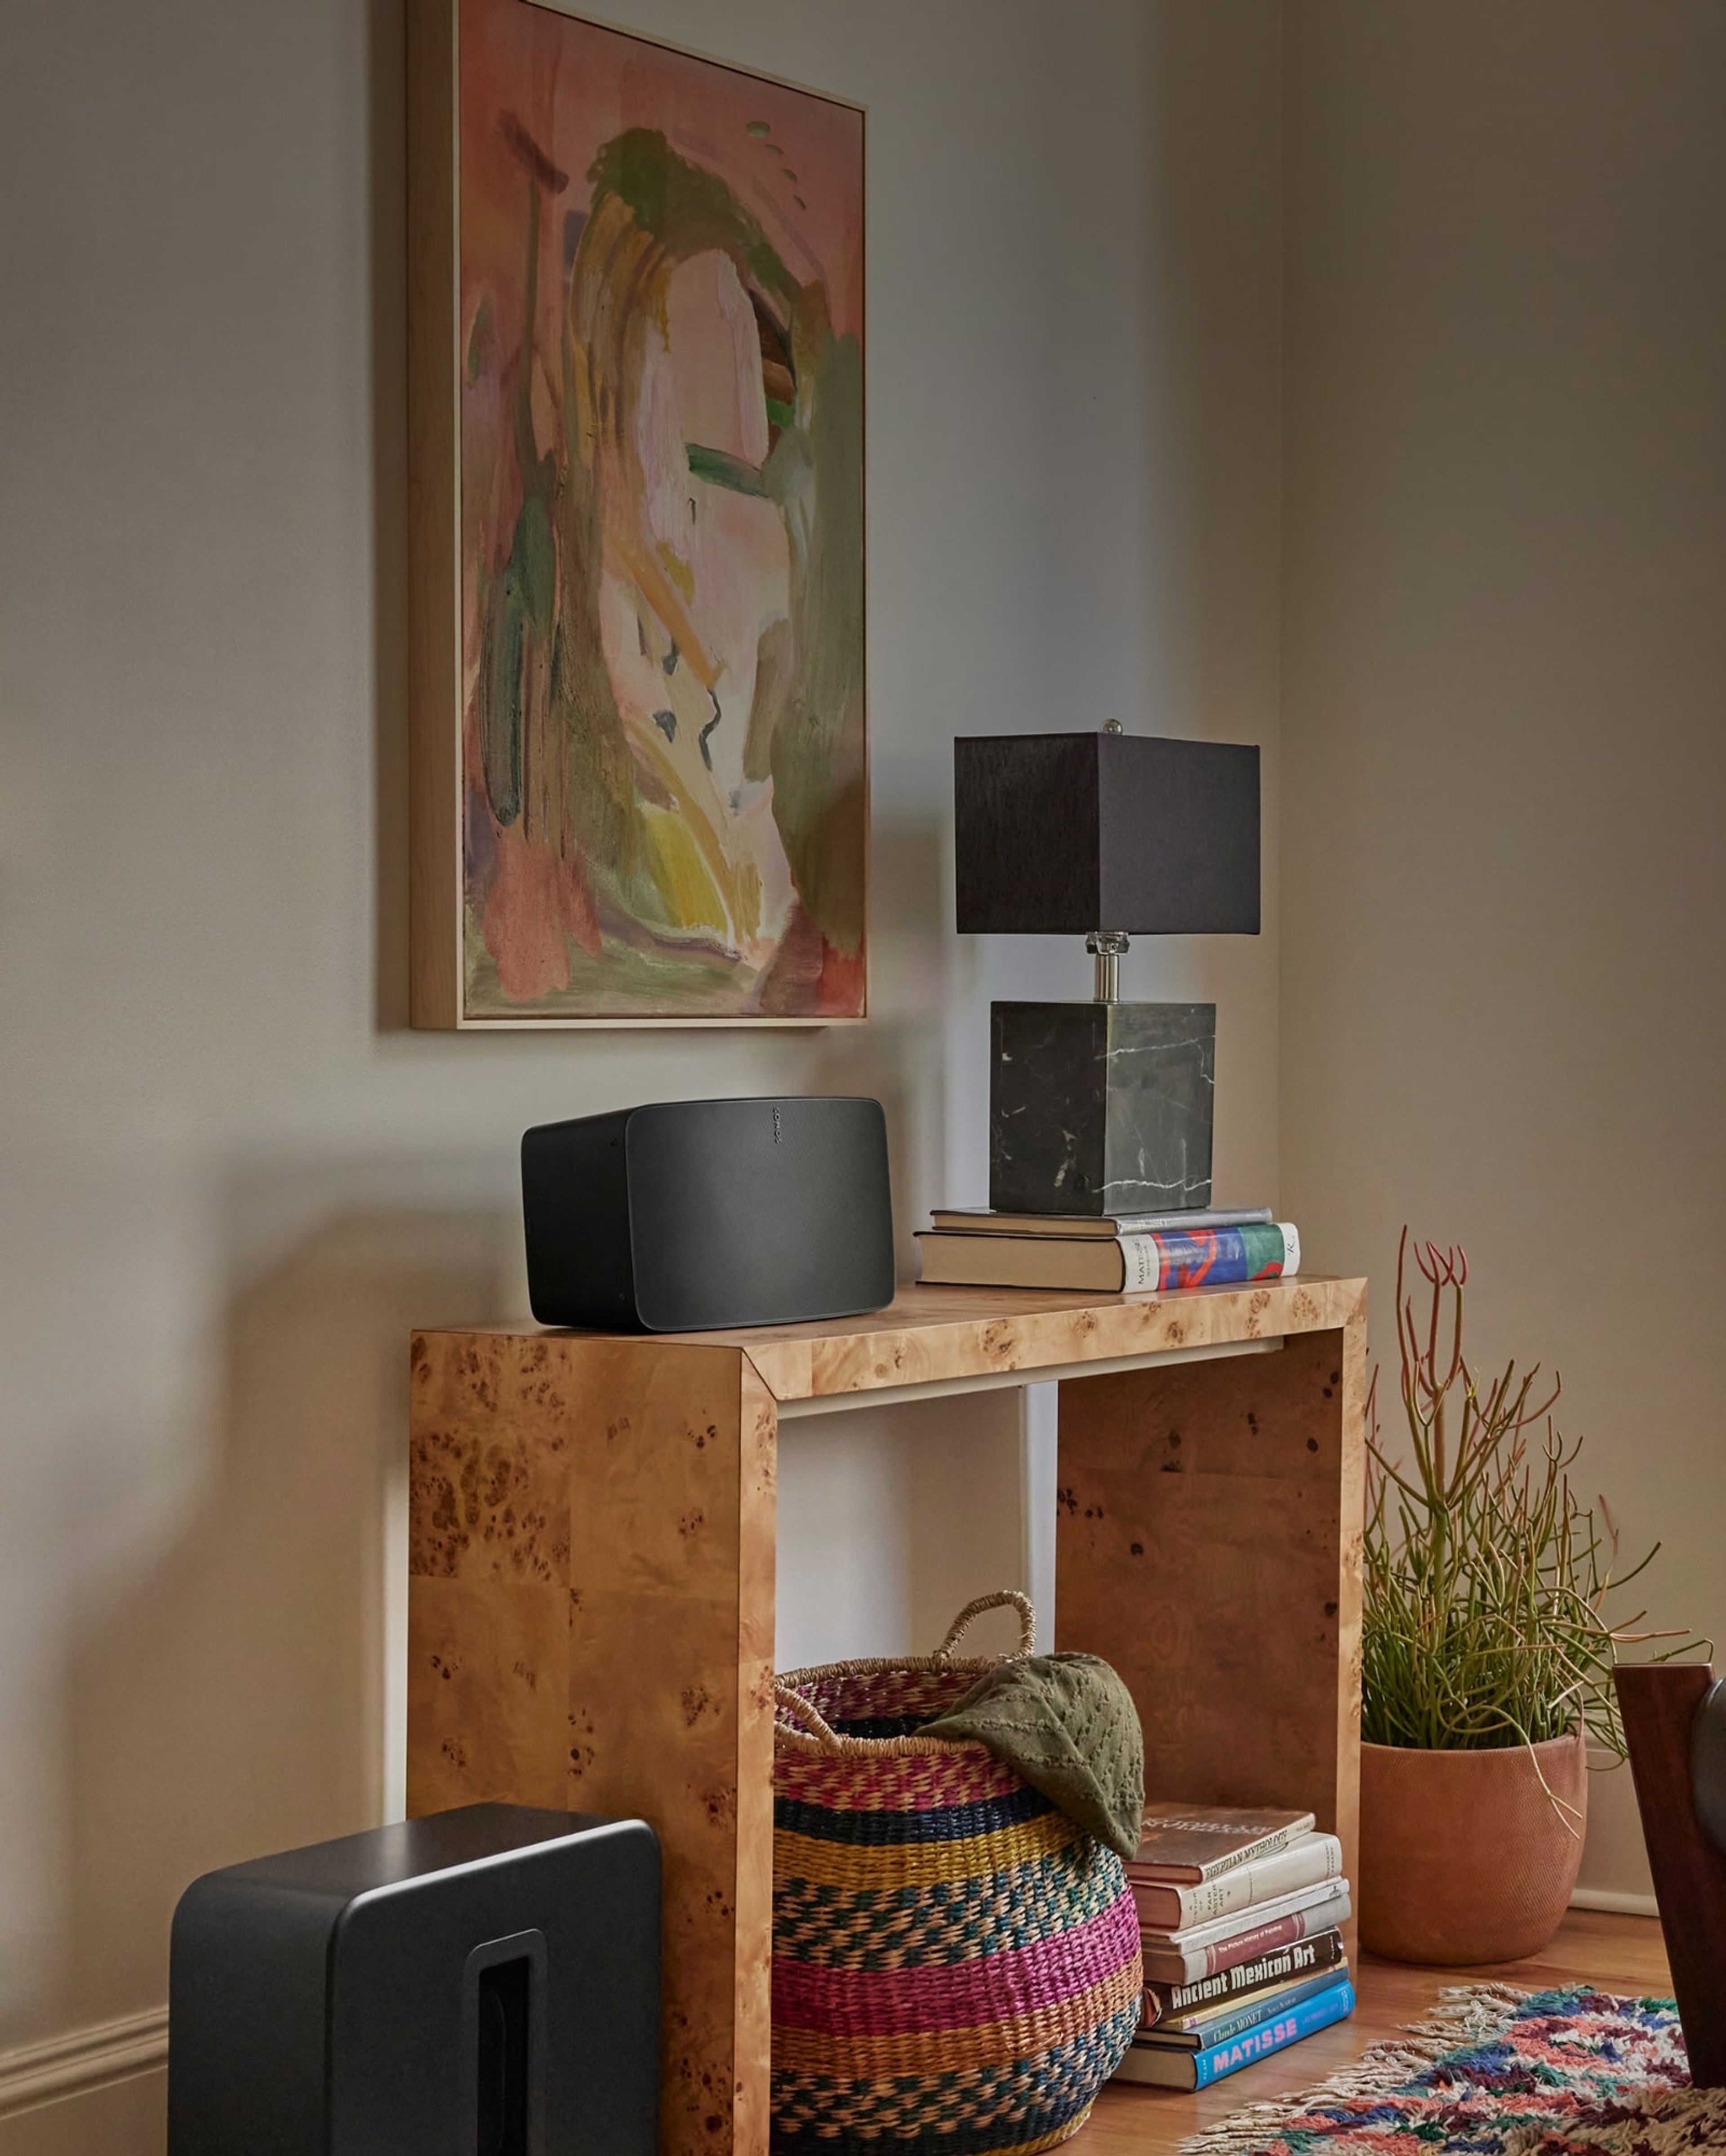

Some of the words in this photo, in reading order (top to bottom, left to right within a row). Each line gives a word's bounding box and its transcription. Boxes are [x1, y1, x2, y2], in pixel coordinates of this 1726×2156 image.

[773, 1107, 782, 1144] SONOS
[1205, 1851, 1244, 1878] EGYPTIAN
[1243, 1830, 1288, 1858] MYTHOLOGY
[1228, 1940, 1243, 1949] Picture
[1244, 1934, 1259, 1942] History
[1172, 1974, 1228, 2009] Ancient
[1230, 1954, 1291, 1990] Mexican
[1294, 1944, 1316, 1969] Art
[1213, 2018, 1297, 2072] MATISSE
[1214, 2023, 1236, 2043] Claude
[1236, 2010, 1262, 2031] MONET
